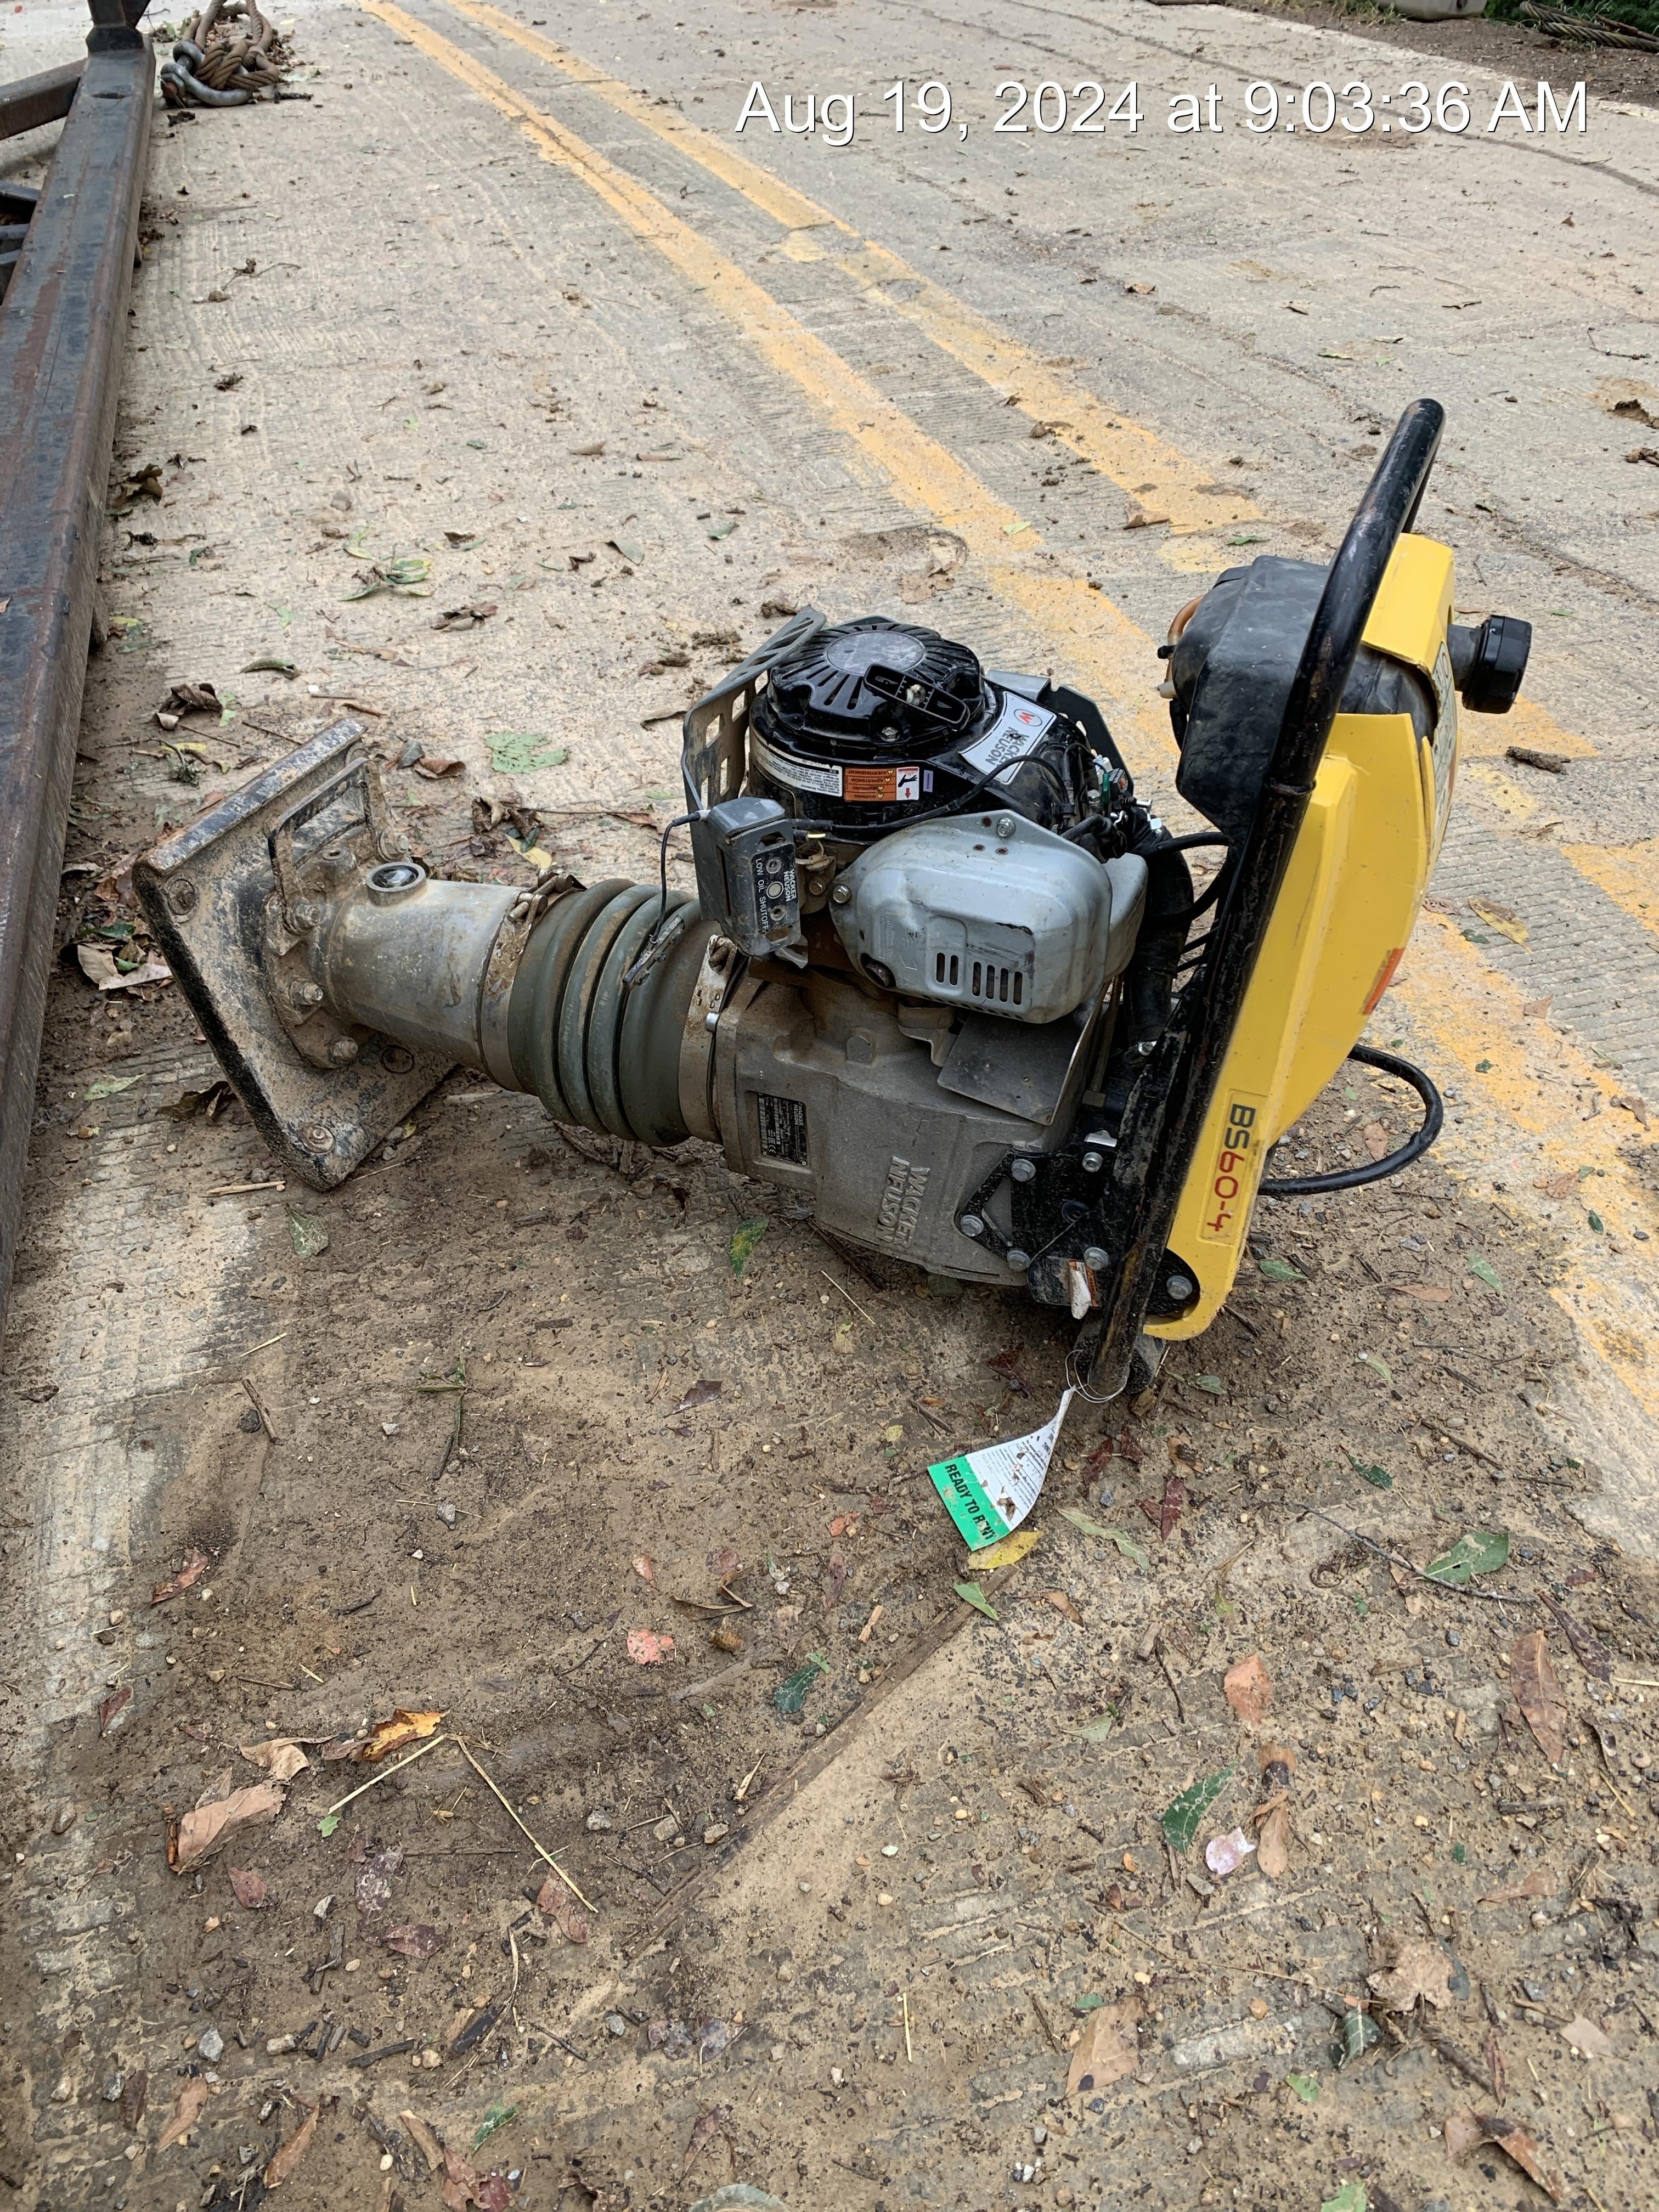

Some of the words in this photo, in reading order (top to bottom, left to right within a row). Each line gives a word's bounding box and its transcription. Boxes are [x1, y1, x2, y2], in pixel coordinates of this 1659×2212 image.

[985, 726, 1018, 765] NEUSON
[760, 896, 769, 930] SHUTOFF
[876, 1155, 910, 1243] NEUSON
[1206, 1103, 1257, 1232] BS60-4
[893, 1167, 931, 1249] WACKER
[945, 1464, 972, 1498] READY
[964, 1499, 980, 1514] TO
